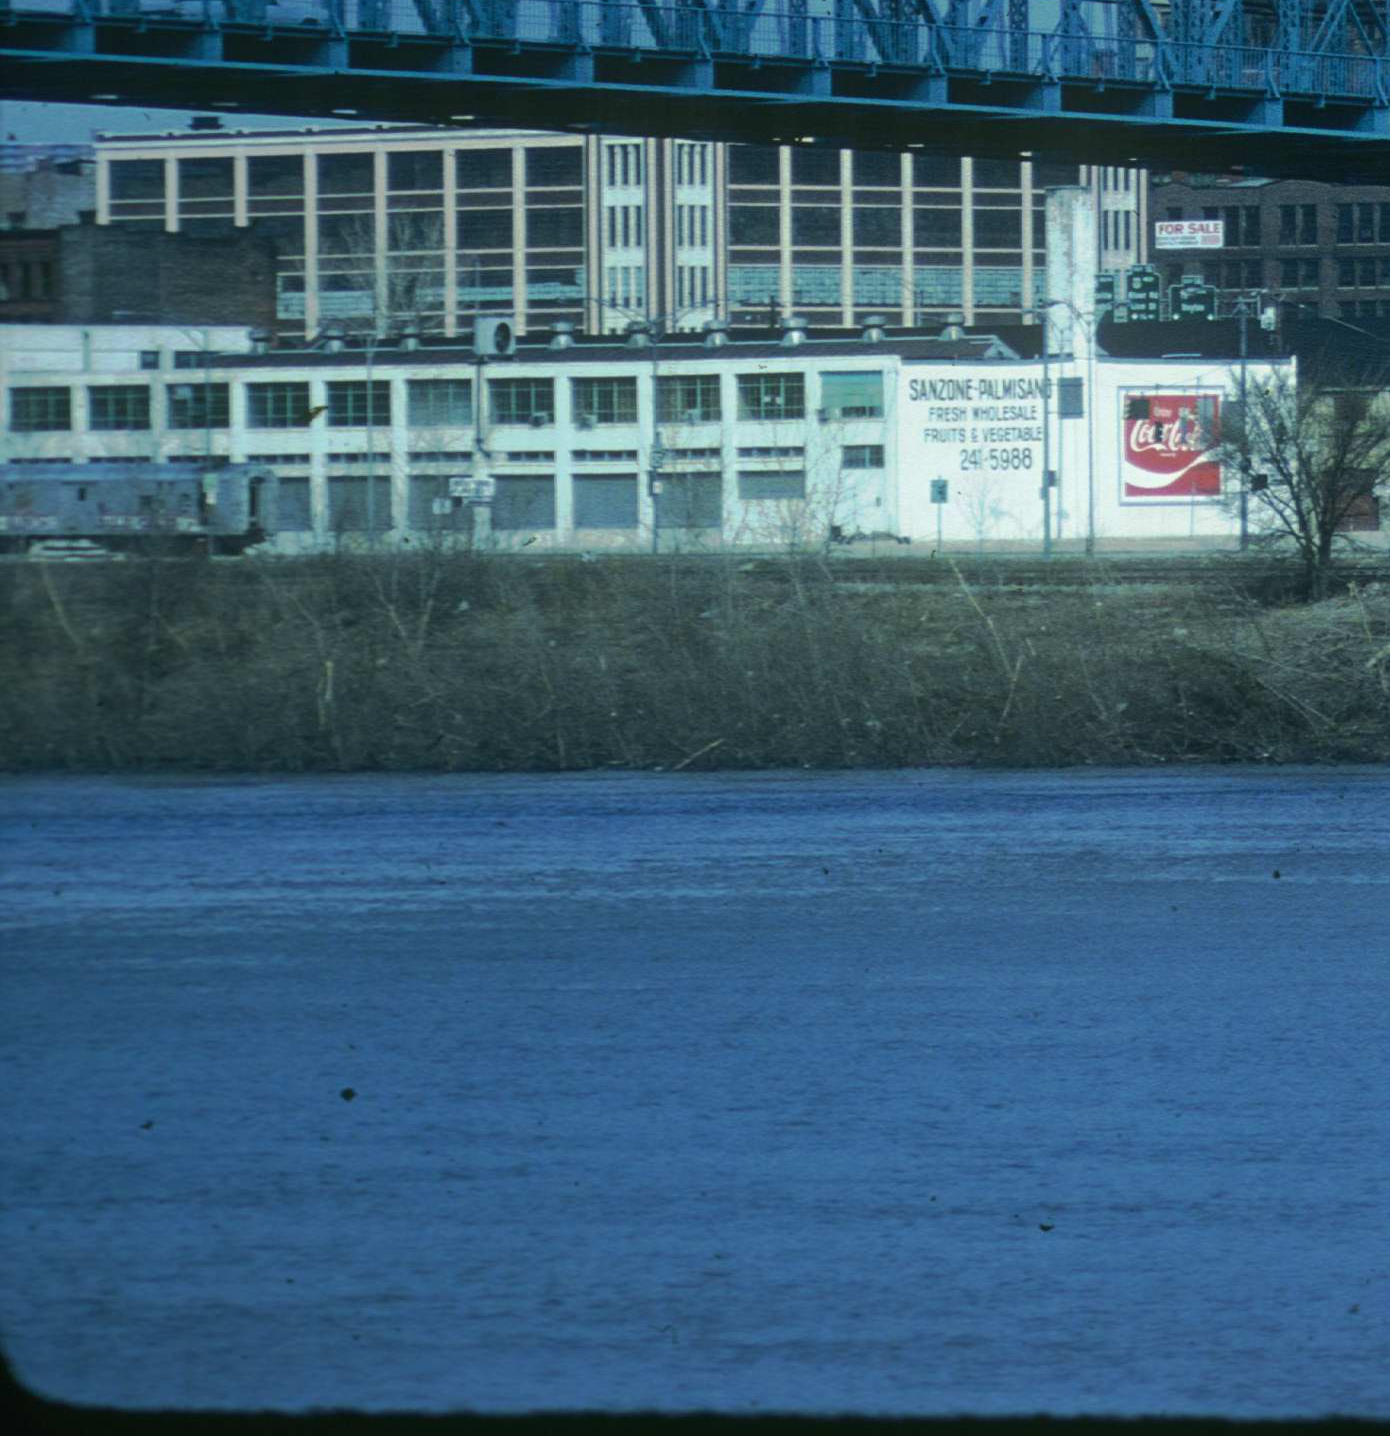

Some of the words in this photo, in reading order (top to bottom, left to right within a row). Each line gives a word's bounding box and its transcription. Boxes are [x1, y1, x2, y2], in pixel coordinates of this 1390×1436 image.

[1158, 224, 1184, 235] FOR
[1188, 223, 1221, 234] SALE
[928, 407, 967, 422] FRESH
[972, 405, 1037, 421] WHOLESALE
[924, 428, 966, 443] FRUITS
[983, 426, 1047, 442] VEGETABLE
